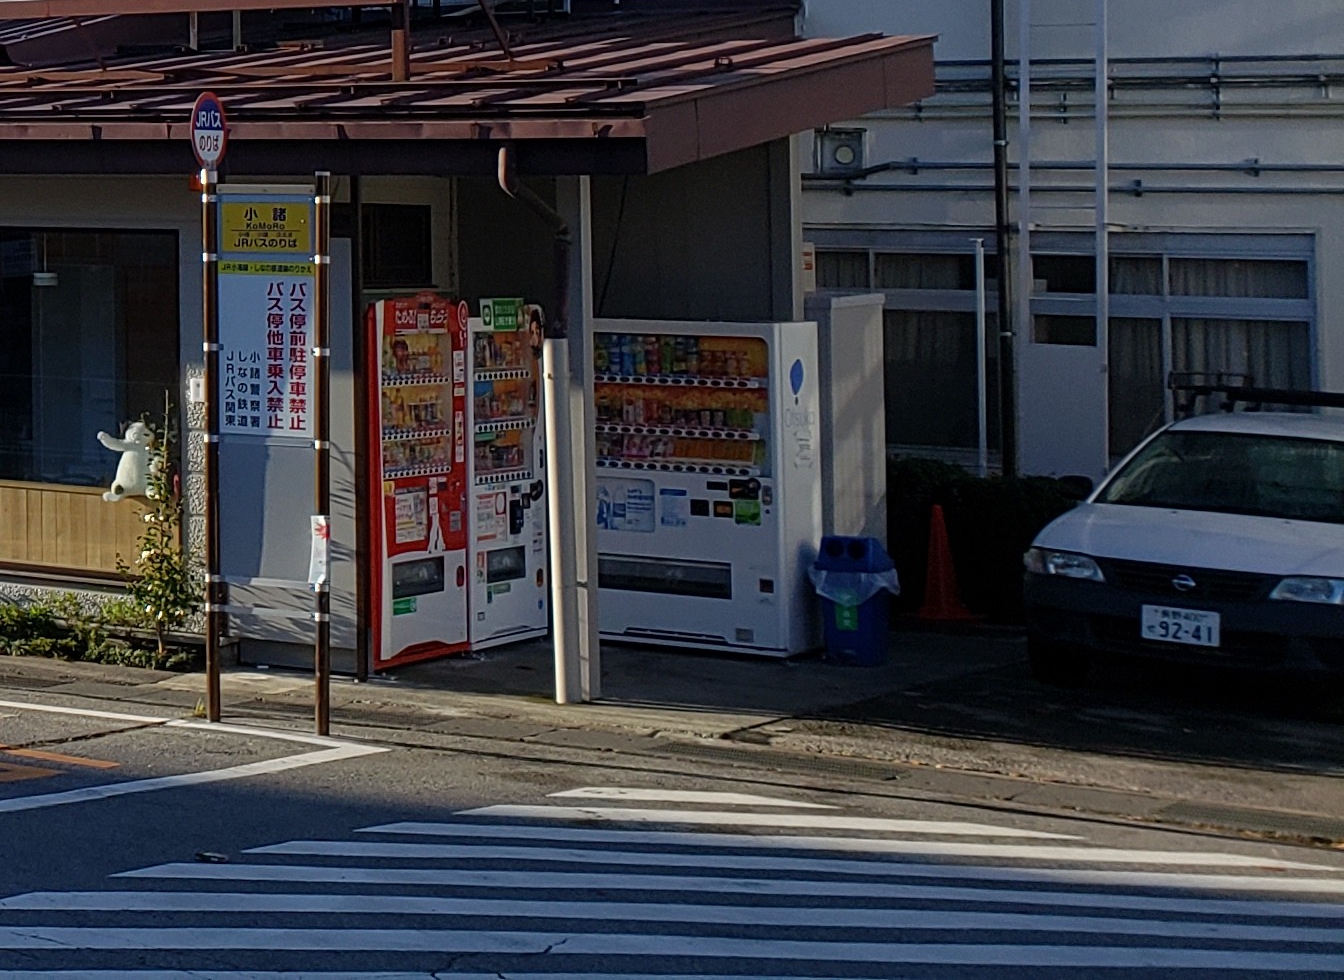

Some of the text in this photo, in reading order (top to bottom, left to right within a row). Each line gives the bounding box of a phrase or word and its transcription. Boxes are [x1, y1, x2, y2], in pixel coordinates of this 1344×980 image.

[195, 110, 223, 129] JRバス
[198, 134, 220, 152] のりば
[244, 207, 287, 222] 小諸
[233, 238, 299, 248] JRバスのりば
[266, 281, 285, 431] バス停他車乗入禁止
[288, 281, 308, 432] バス停前駐停車禁止
[224, 350, 236, 427] JRバス関東
[237, 350, 249, 428] しなの鉄道
[249, 350, 261, 429] 小諸警察署
[1158, 621, 1212, 643] 92-41
